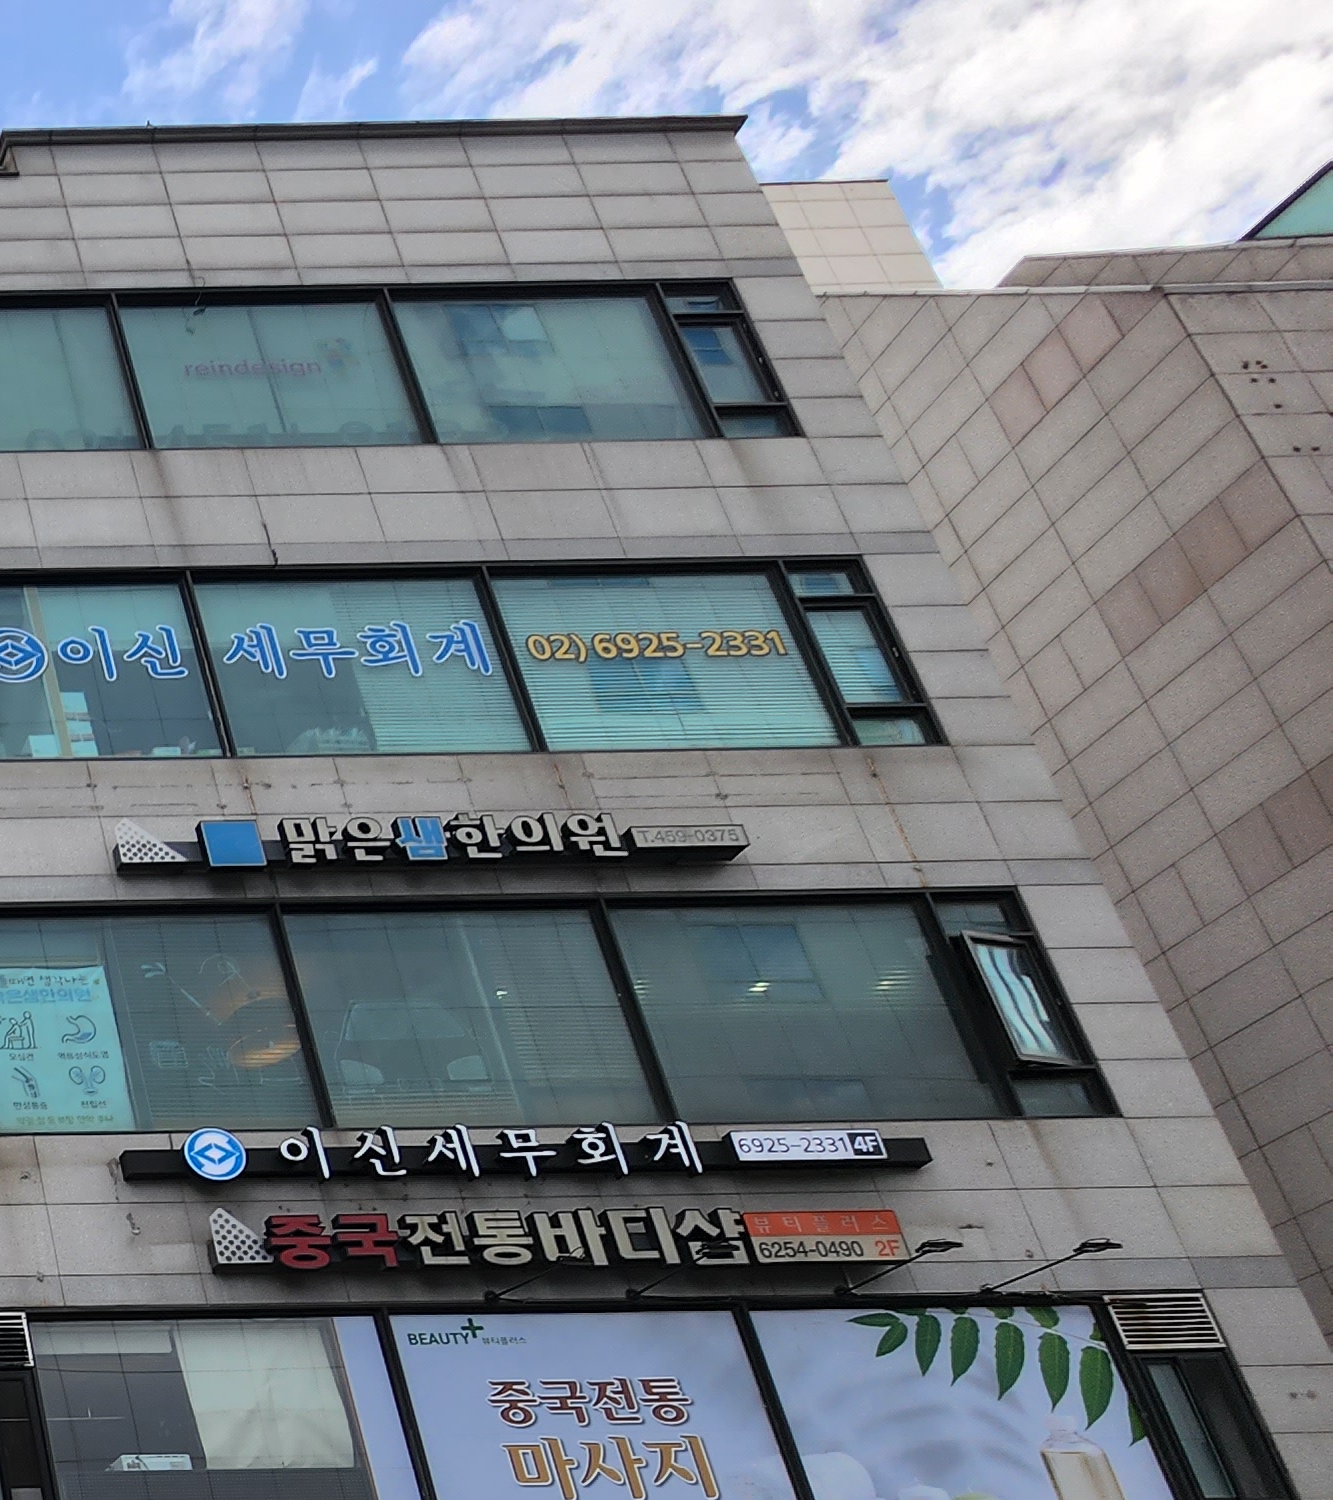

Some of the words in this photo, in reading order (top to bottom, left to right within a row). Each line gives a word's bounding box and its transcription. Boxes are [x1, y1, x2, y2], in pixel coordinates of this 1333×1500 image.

[56, 623, 189, 684] 이신
[223, 619, 494, 680] 세무회계
[737, 1135, 848, 1157] 6925-2331
[853, 1135, 880, 1157] 4F
[752, 1214, 888, 1234] 뷰티플러스
[758, 1239, 865, 1260] 6254-0490
[875, 1239, 901, 1258] 2F
[486, 1375, 692, 1428] 중국전통
